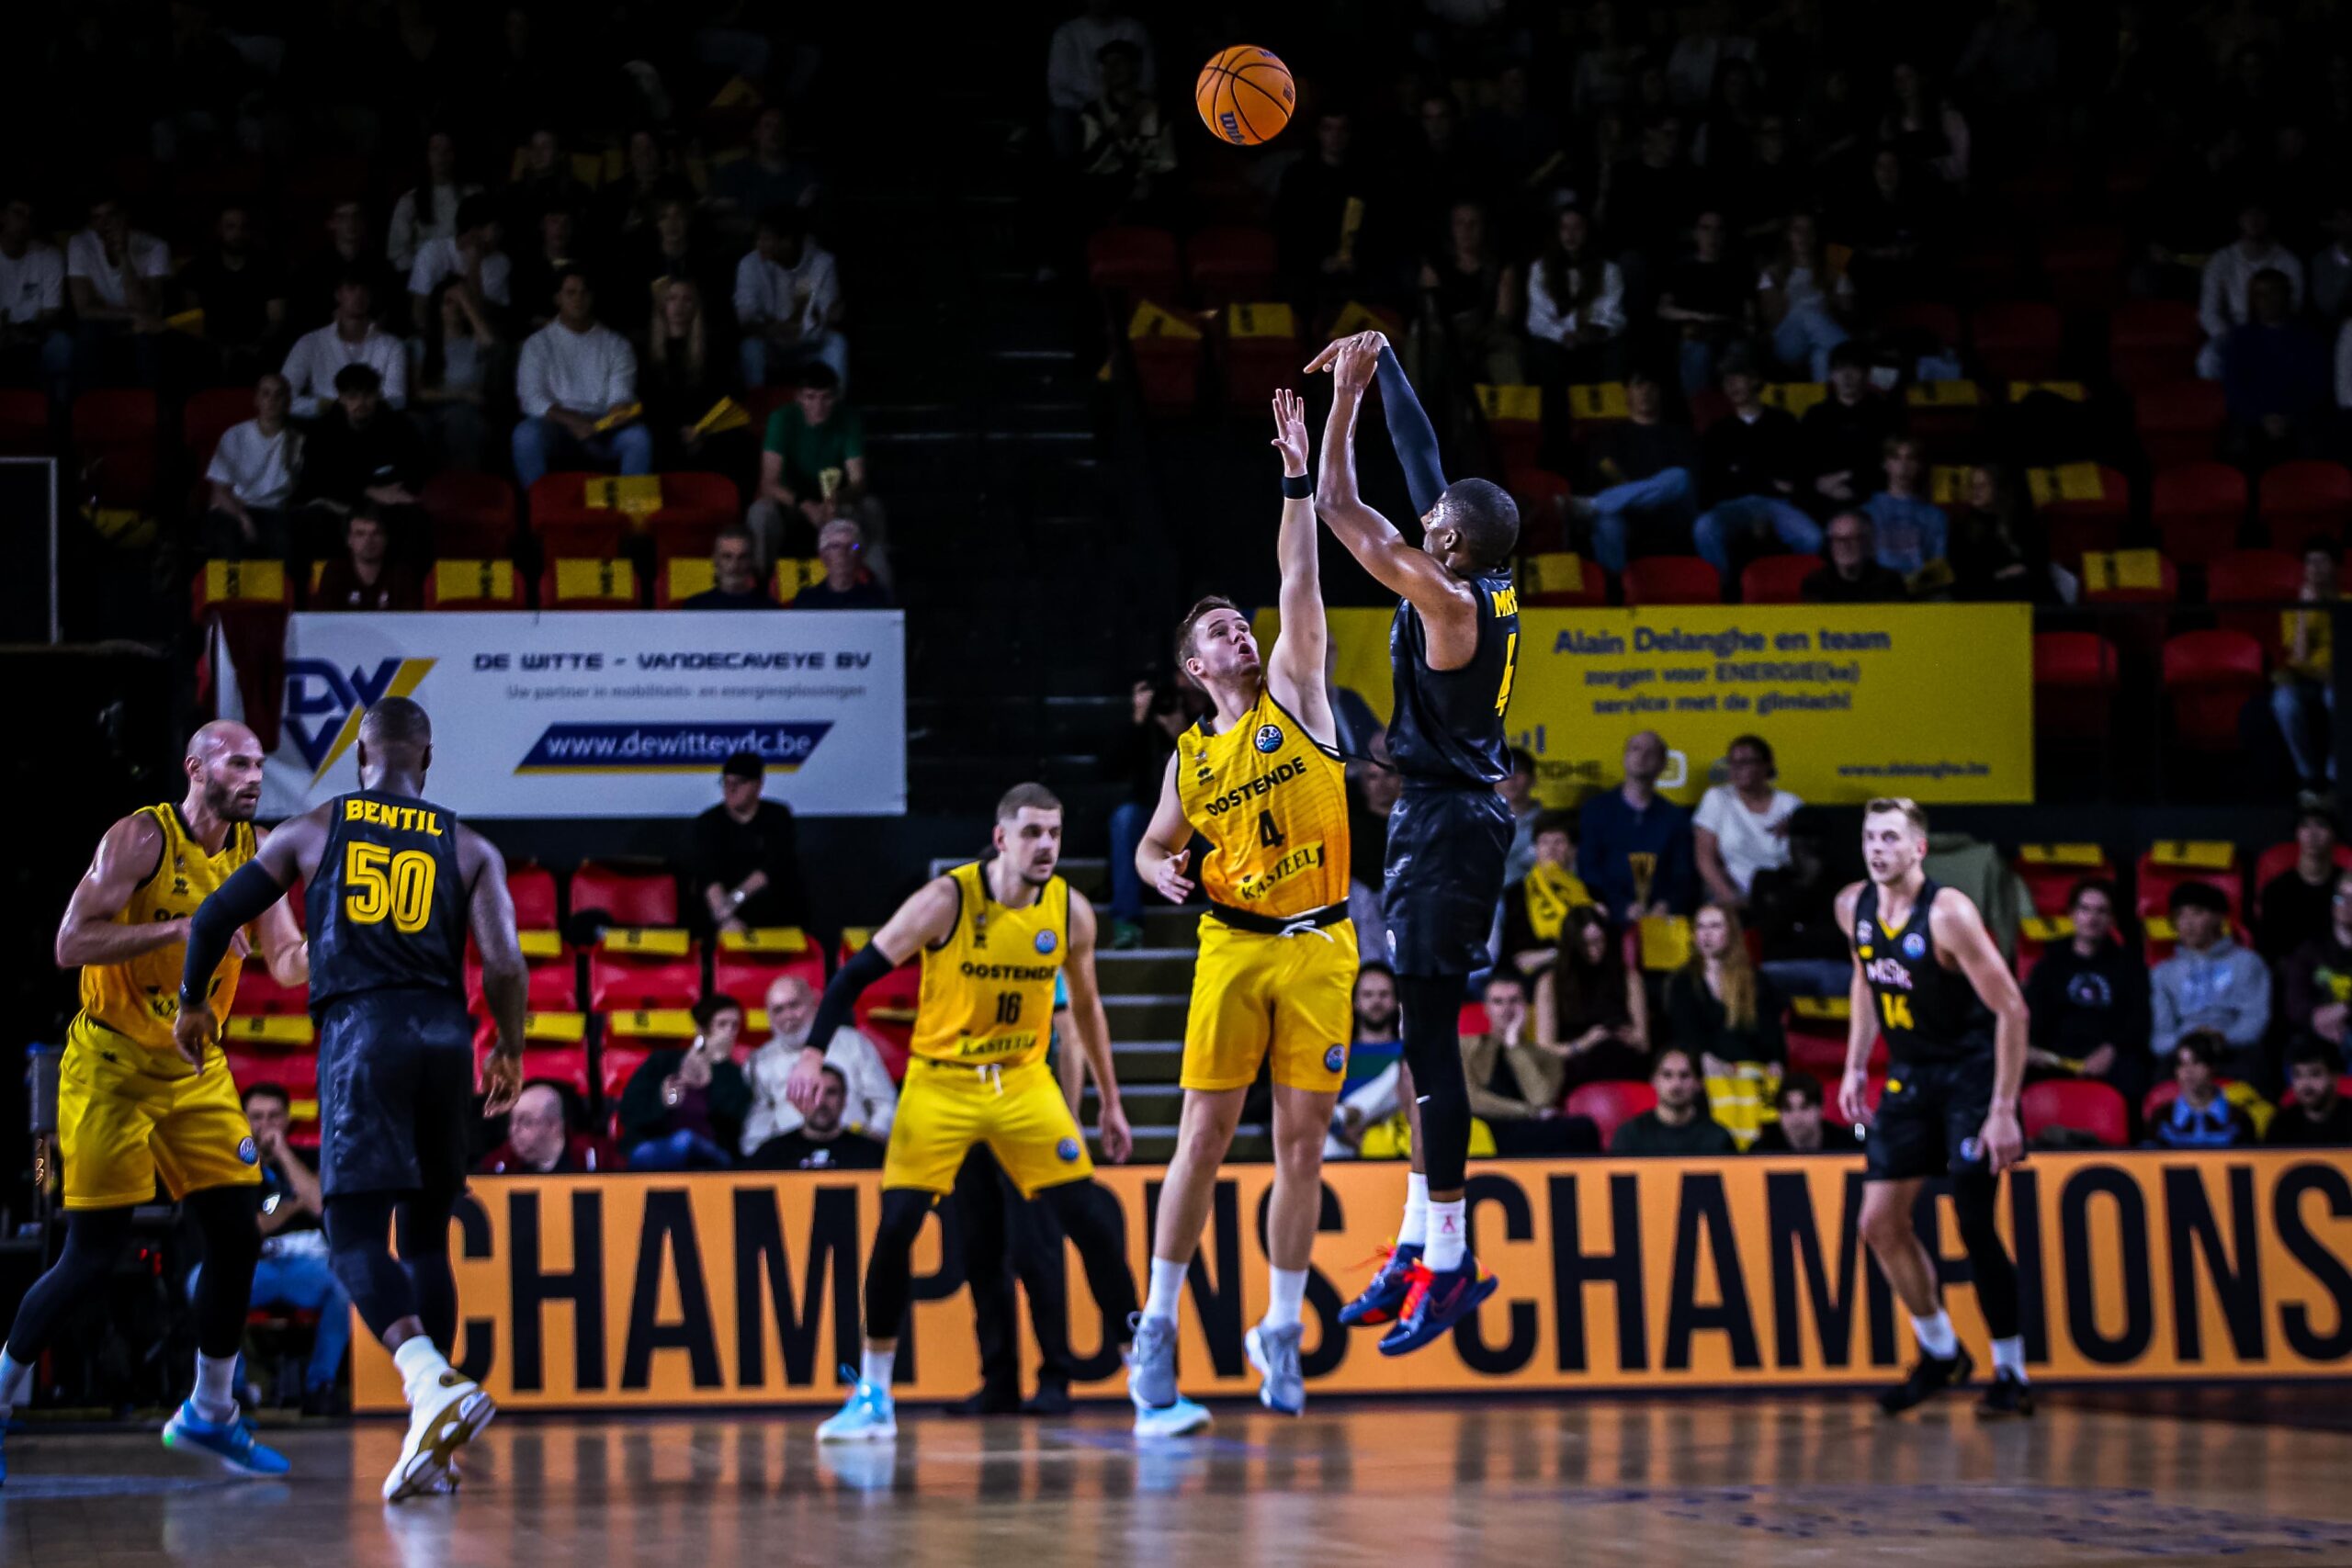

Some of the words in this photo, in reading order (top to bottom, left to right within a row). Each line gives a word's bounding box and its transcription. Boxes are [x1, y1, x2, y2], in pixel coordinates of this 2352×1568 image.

[473, 653, 511, 671] DE
[520, 653, 604, 671] WITTE
[637, 652, 826, 671] VANDECAVEYE
[834, 652, 872, 671] BV
[1554, 628, 1625, 654] Alain
[1634, 626, 1765, 658] Delanghe
[1774, 633, 1810, 651] en
[1818, 628, 1892, 651] team
[1204, 756, 1307, 817] OOSTENDE
[345, 798, 443, 837] BENTIL
[1259, 808, 1285, 849] 4
[345, 840, 436, 933] 50
